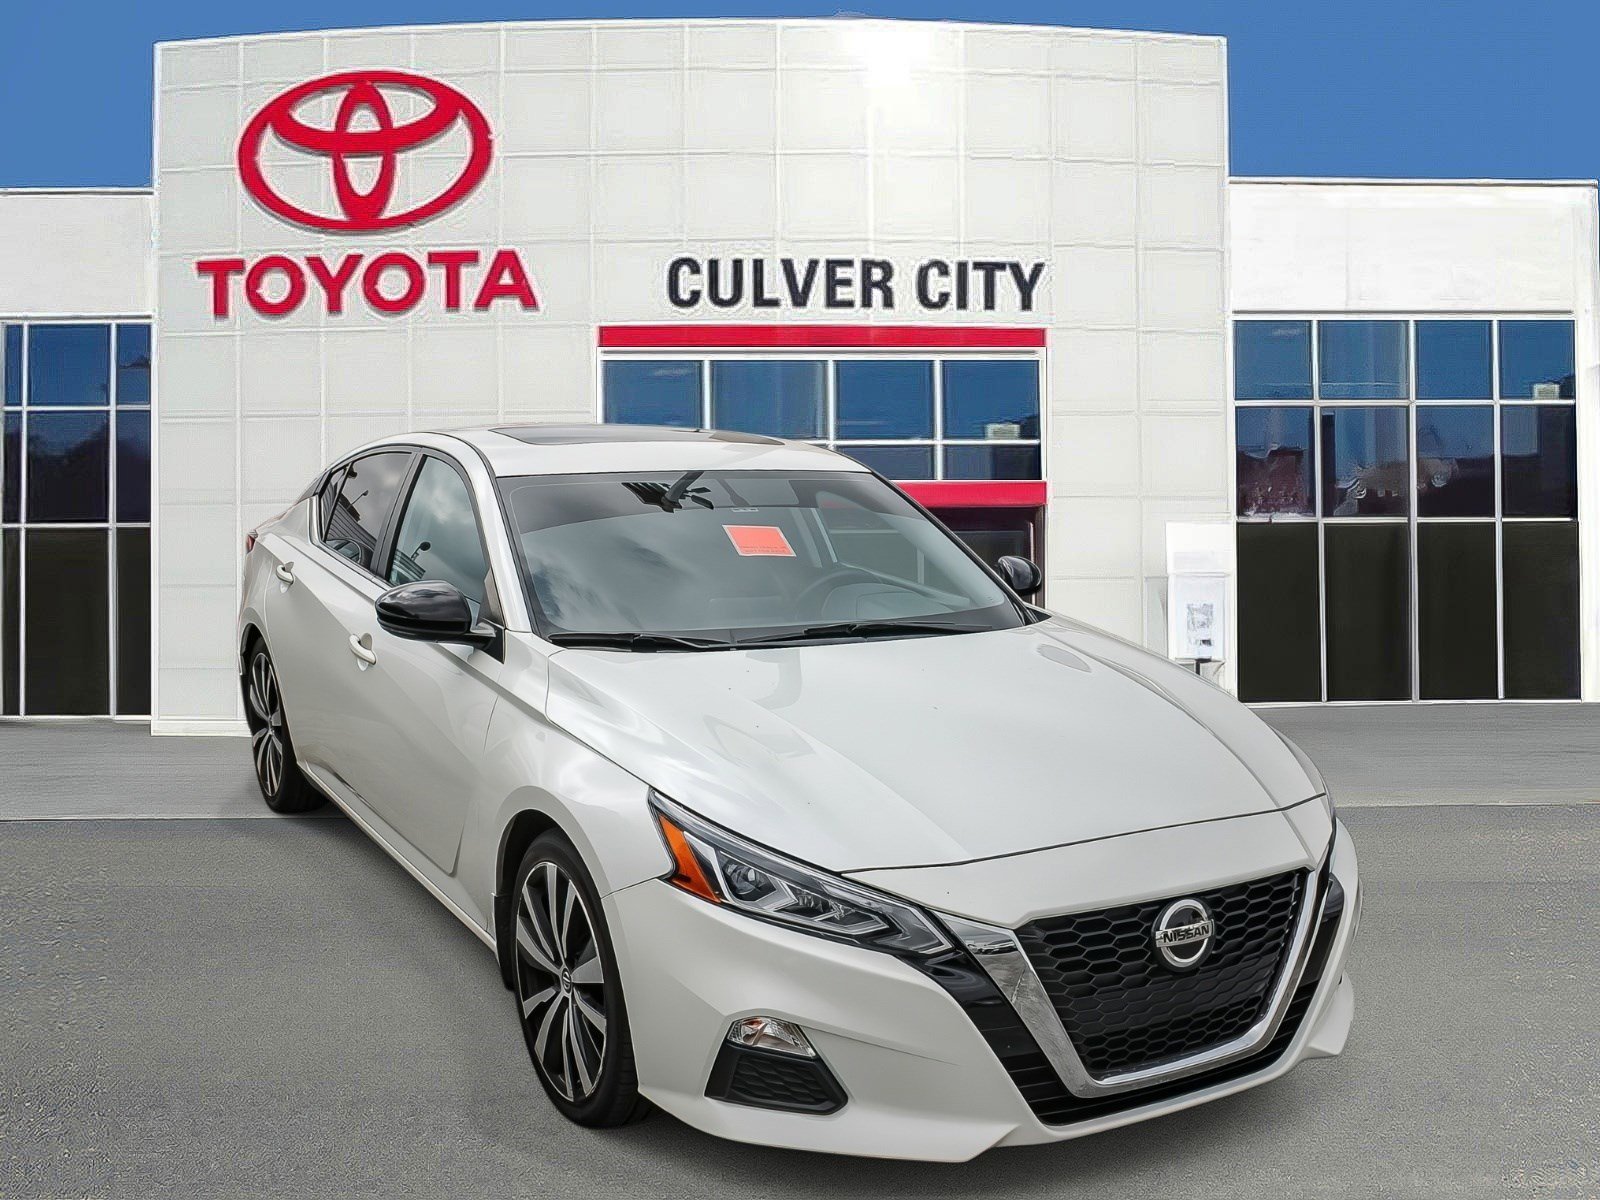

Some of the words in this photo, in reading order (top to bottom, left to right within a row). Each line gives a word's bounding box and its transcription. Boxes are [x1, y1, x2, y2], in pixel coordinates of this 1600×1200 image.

[197, 249, 538, 318] TOYOTA
[668, 257, 894, 309] CULVER
[917, 259, 1045, 311] CITY
[1163, 924, 1210, 943] NISSAN
